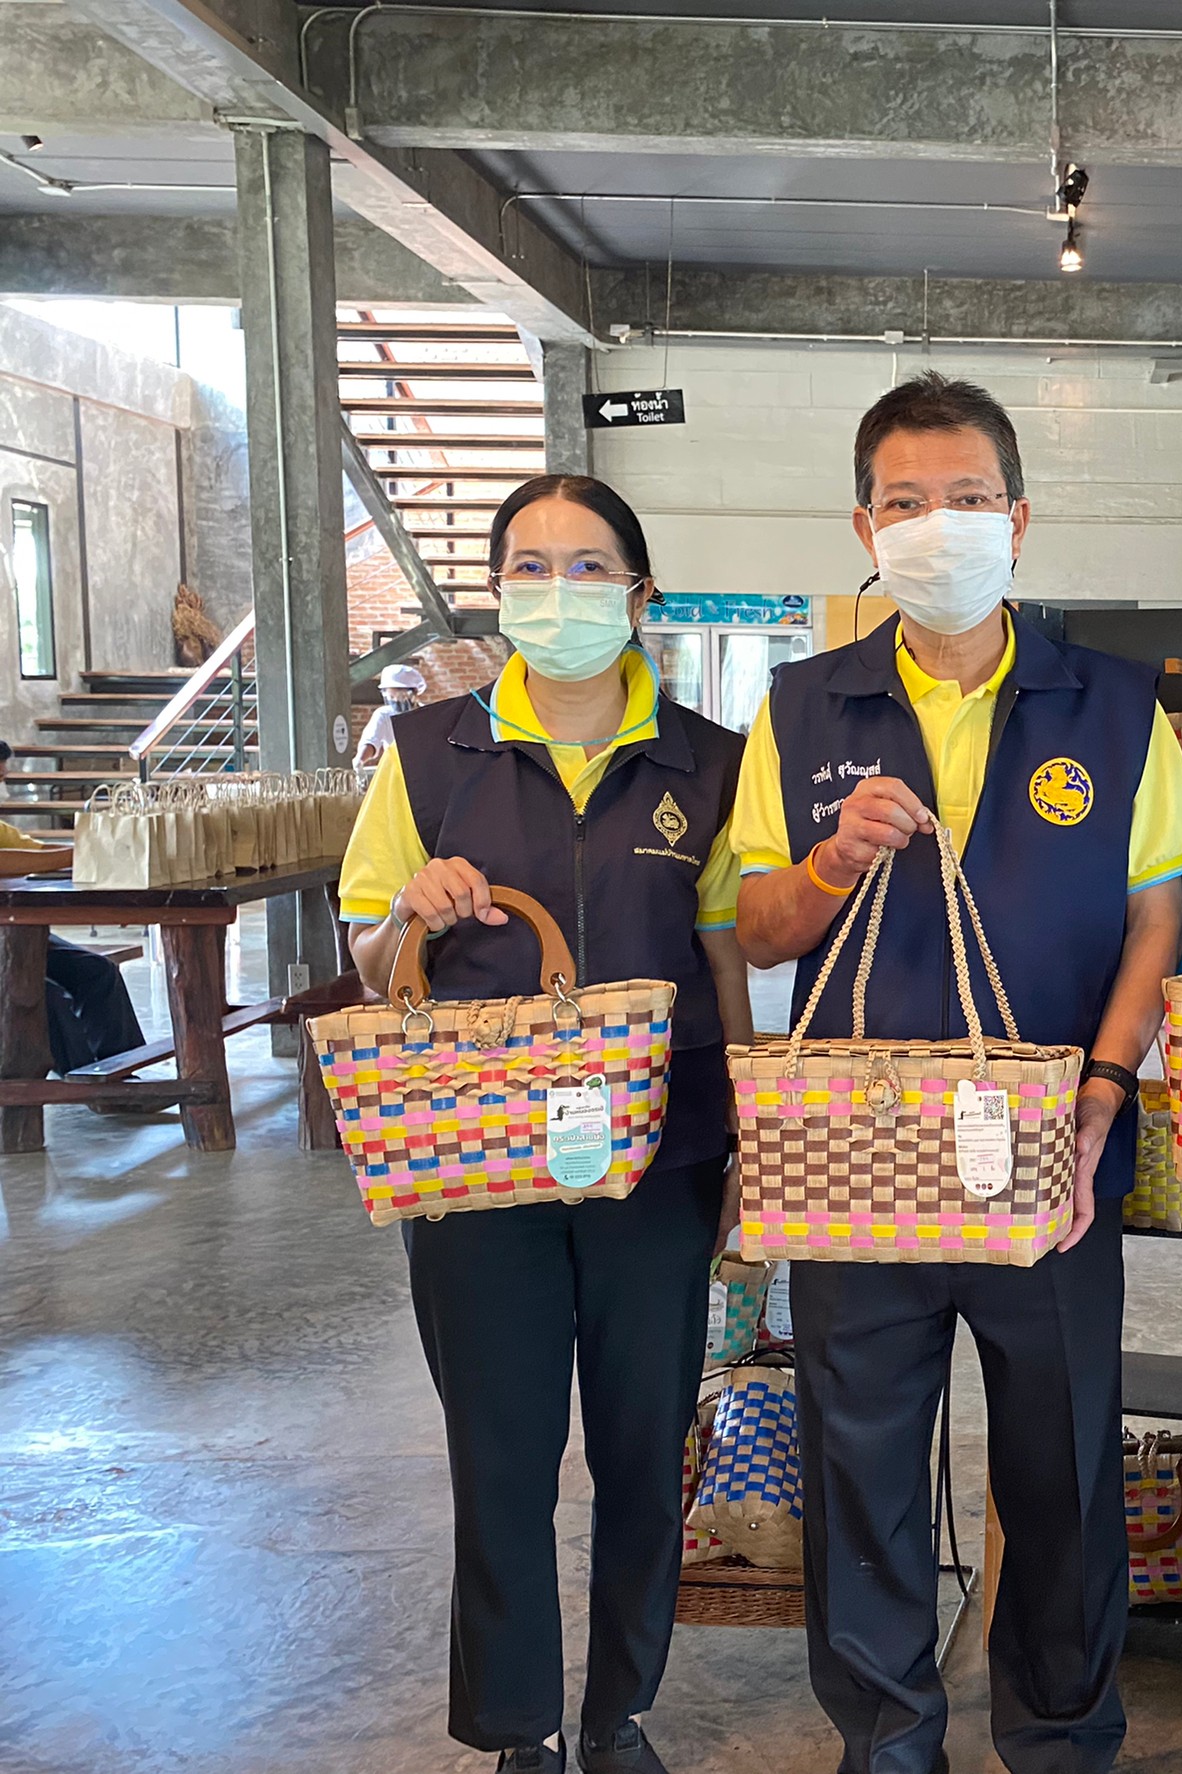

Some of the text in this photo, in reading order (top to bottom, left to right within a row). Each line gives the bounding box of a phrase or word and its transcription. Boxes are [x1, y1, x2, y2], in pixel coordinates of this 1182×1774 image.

[631, 392, 669, 411] ห้องน้ำ
[636, 412, 665, 423] Toilet
